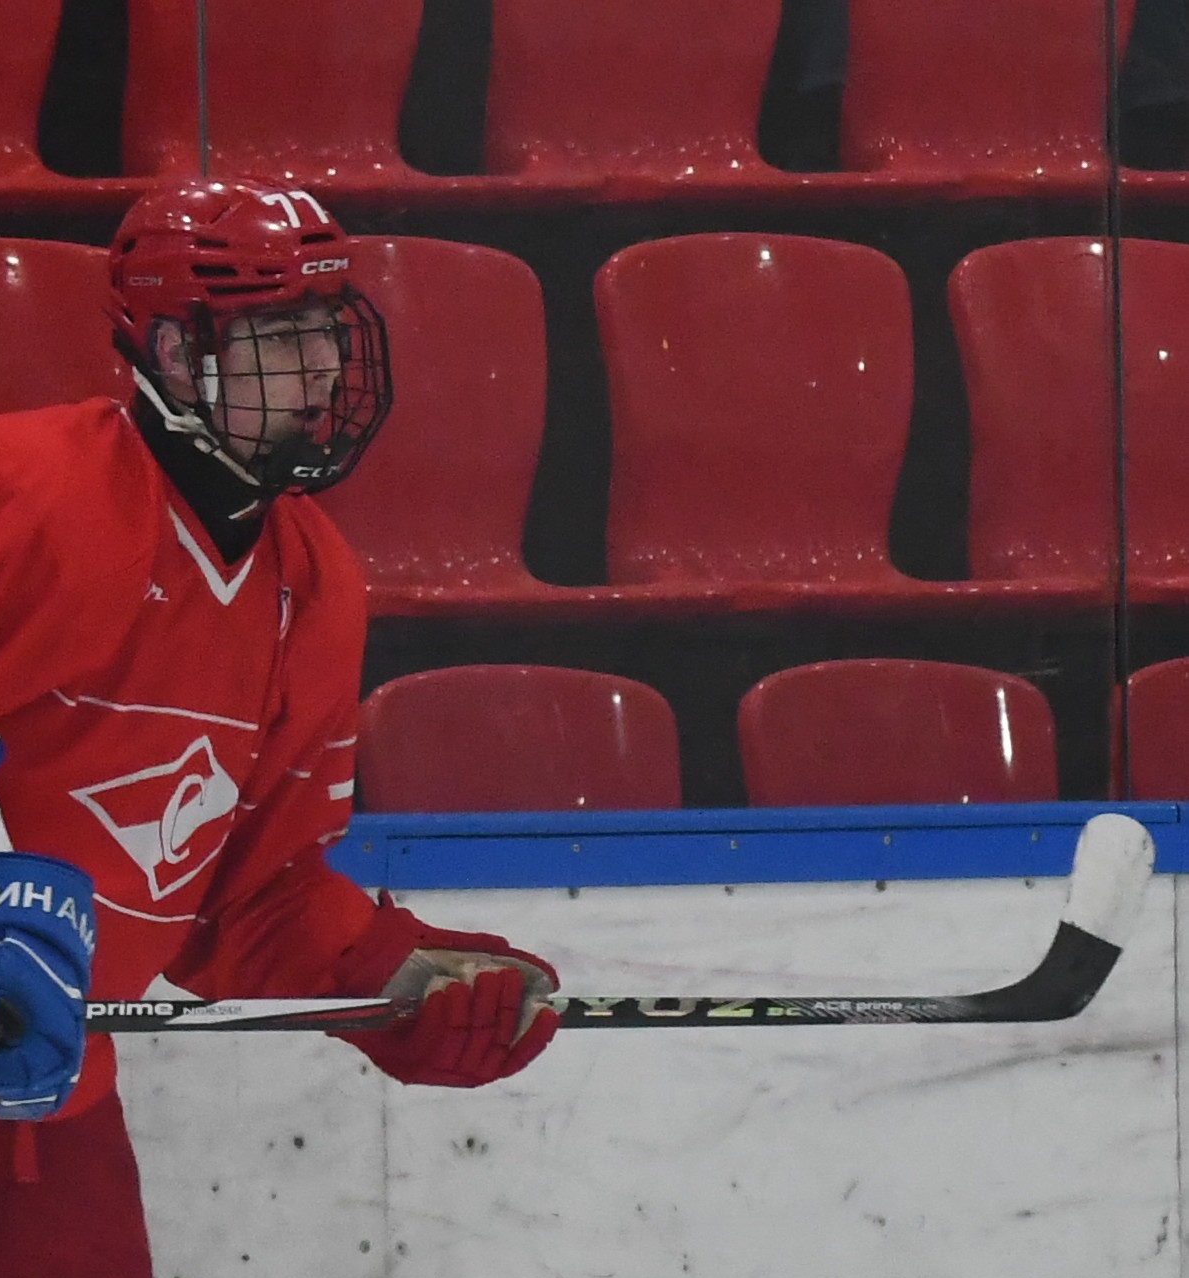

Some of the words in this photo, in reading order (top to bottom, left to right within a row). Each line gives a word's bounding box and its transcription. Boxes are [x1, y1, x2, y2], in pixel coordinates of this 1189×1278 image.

[261, 190, 329, 228] 77
[301, 258, 349, 275] CCM
[86, 1000, 174, 1020] prime
